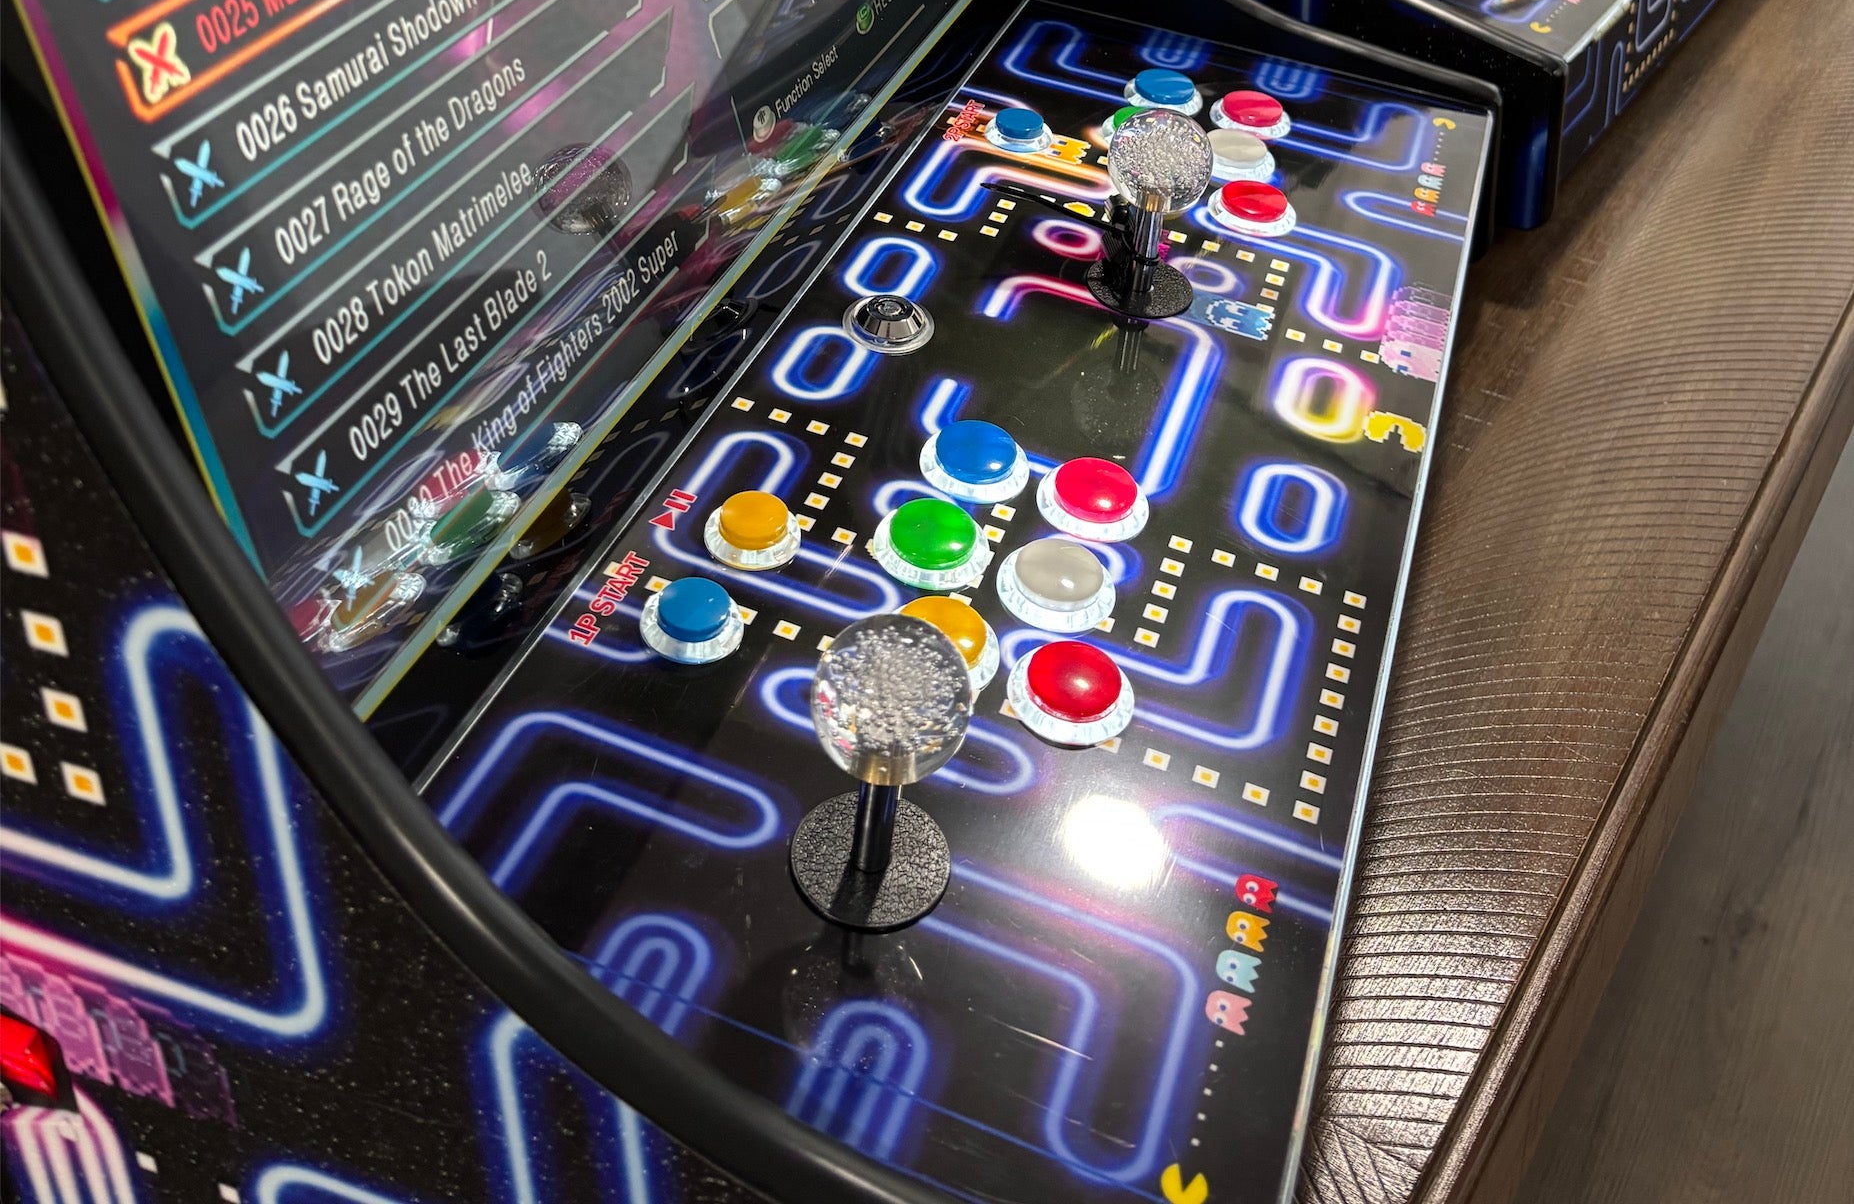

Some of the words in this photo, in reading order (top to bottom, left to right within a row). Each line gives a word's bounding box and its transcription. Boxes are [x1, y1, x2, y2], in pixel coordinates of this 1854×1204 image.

[236, 93, 297, 162] 0026
[295, 32, 390, 119] Samurai
[274, 194, 331, 265] 0027
[331, 160, 391, 222] Rage
[391, 132, 416, 175] of
[414, 117, 451, 157] the
[447, 57, 527, 132] Dragons
[774, 74, 814, 119] Function
[811, 45, 839, 80] Select
[312, 300, 370, 366] 0028
[365, 246, 434, 317] Tokon
[431, 161, 534, 262] Matrimelee
[348, 390, 403, 462] 0029
[399, 367, 442, 419] The
[438, 318, 486, 374] Last
[483, 277, 538, 330] Blade
[536, 249, 552, 282] 2
[432, 451, 474, 501] The
[470, 404, 518, 452] King
[517, 374, 538, 413] of
[535, 312, 603, 394] Fighters
[601, 268, 640, 325] 2002
[637, 229, 680, 284] Super
[569, 613, 601, 645] 1P
[590, 551, 650, 616] START
